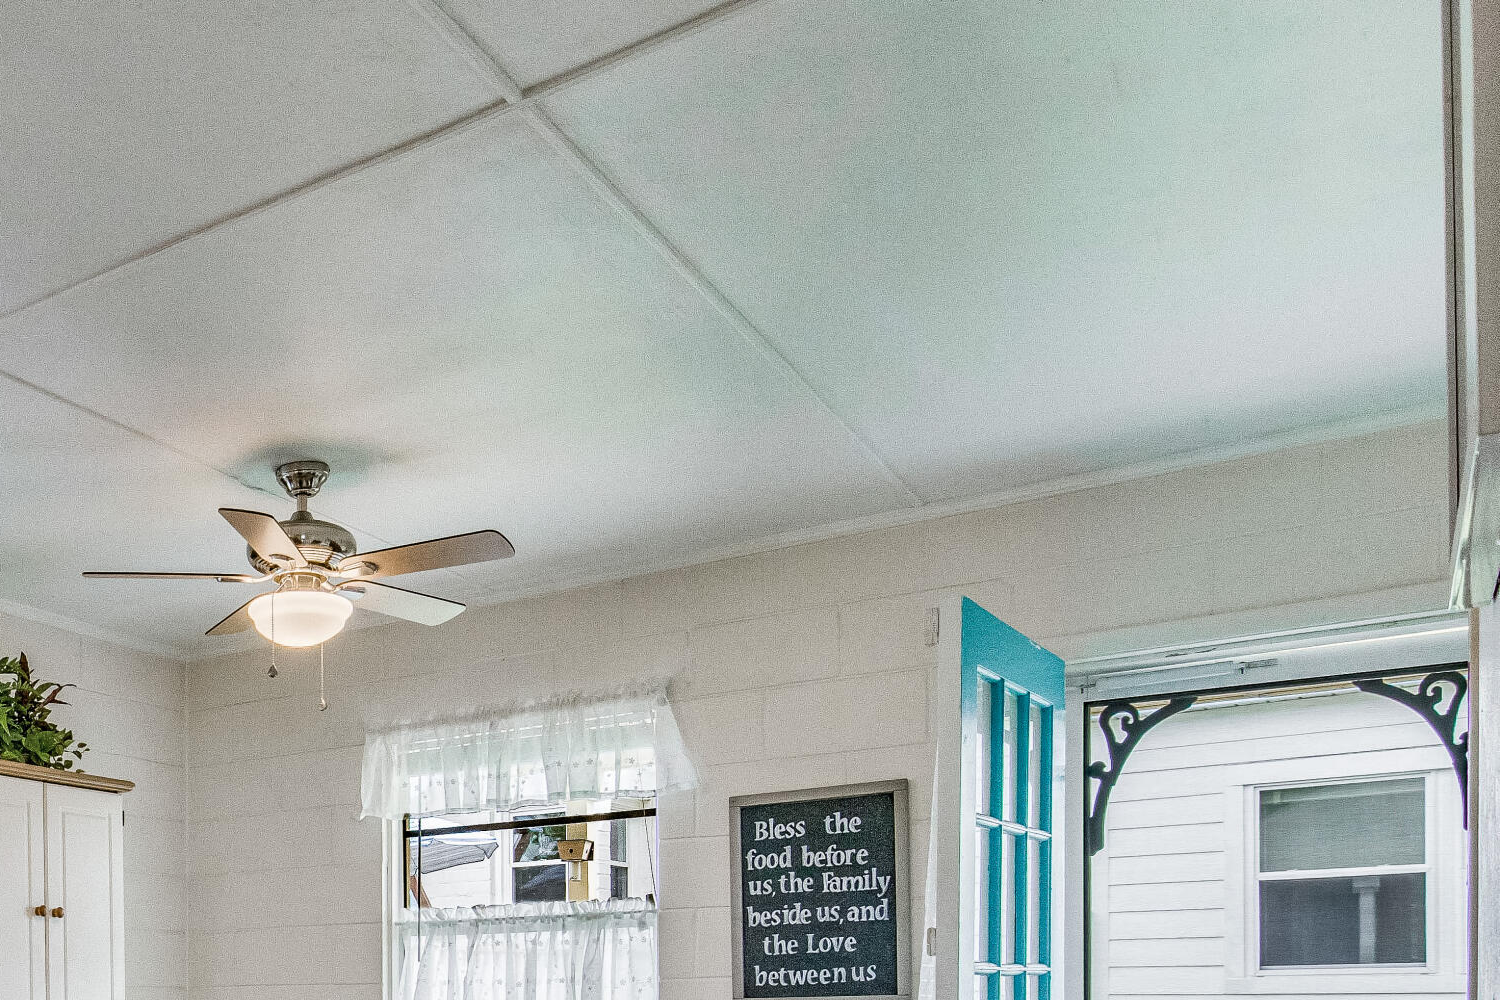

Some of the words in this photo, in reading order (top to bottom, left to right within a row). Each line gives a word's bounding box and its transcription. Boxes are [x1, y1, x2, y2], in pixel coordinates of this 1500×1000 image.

[754, 818, 806, 842] Bless
[824, 812, 862, 835] the
[746, 846, 792, 871] food
[801, 844, 869, 868] before
[748, 878, 776, 898] us,
[778, 872, 814, 893] the
[822, 867, 891, 898] Family
[746, 903, 812, 928] beside
[762, 934, 799, 956] the
[806, 934, 857, 954] Love
[754, 965, 847, 988] between
[850, 964, 877, 982] us
